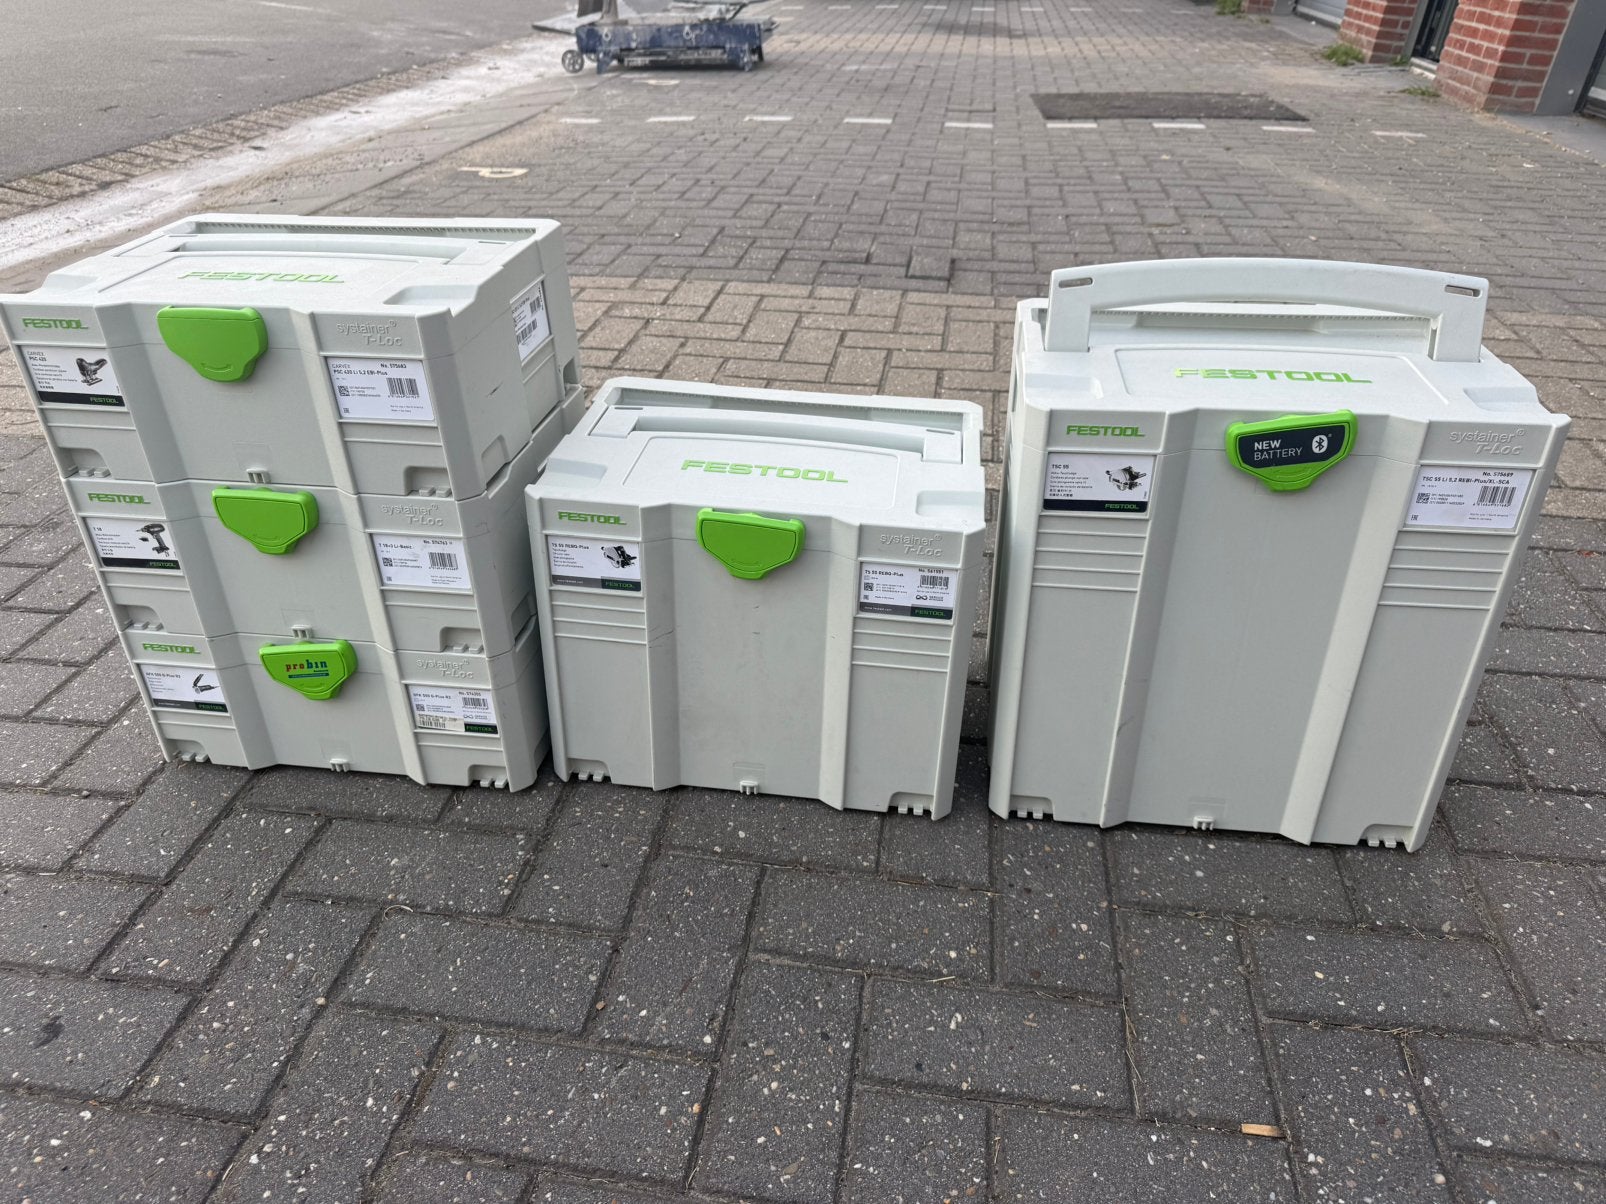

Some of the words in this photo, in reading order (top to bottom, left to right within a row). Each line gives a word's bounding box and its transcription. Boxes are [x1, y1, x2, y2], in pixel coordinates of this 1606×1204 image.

[177, 271, 345, 283] FESTOOL
[22, 318, 89, 329] FESTOOL
[363, 335, 403, 346] T-Loc
[1174, 368, 1373, 384] FESTOOL
[90, 396, 119, 404] FESTOOL
[1066, 425, 1146, 437] FESTOOL
[1254, 439, 1282, 450] NEW
[1475, 442, 1524, 455] T-Loc
[1254, 447, 1303, 461] BATTERY
[681, 460, 848, 483] FESTOOL
[88, 493, 151, 505] FESTOOL
[406, 515, 443, 526] T-Loc
[558, 511, 627, 525] FESTOOL
[904, 545, 942, 556] T-Loc
[142, 643, 201, 655] FESTOOL
[285, 659, 328, 672] probin
